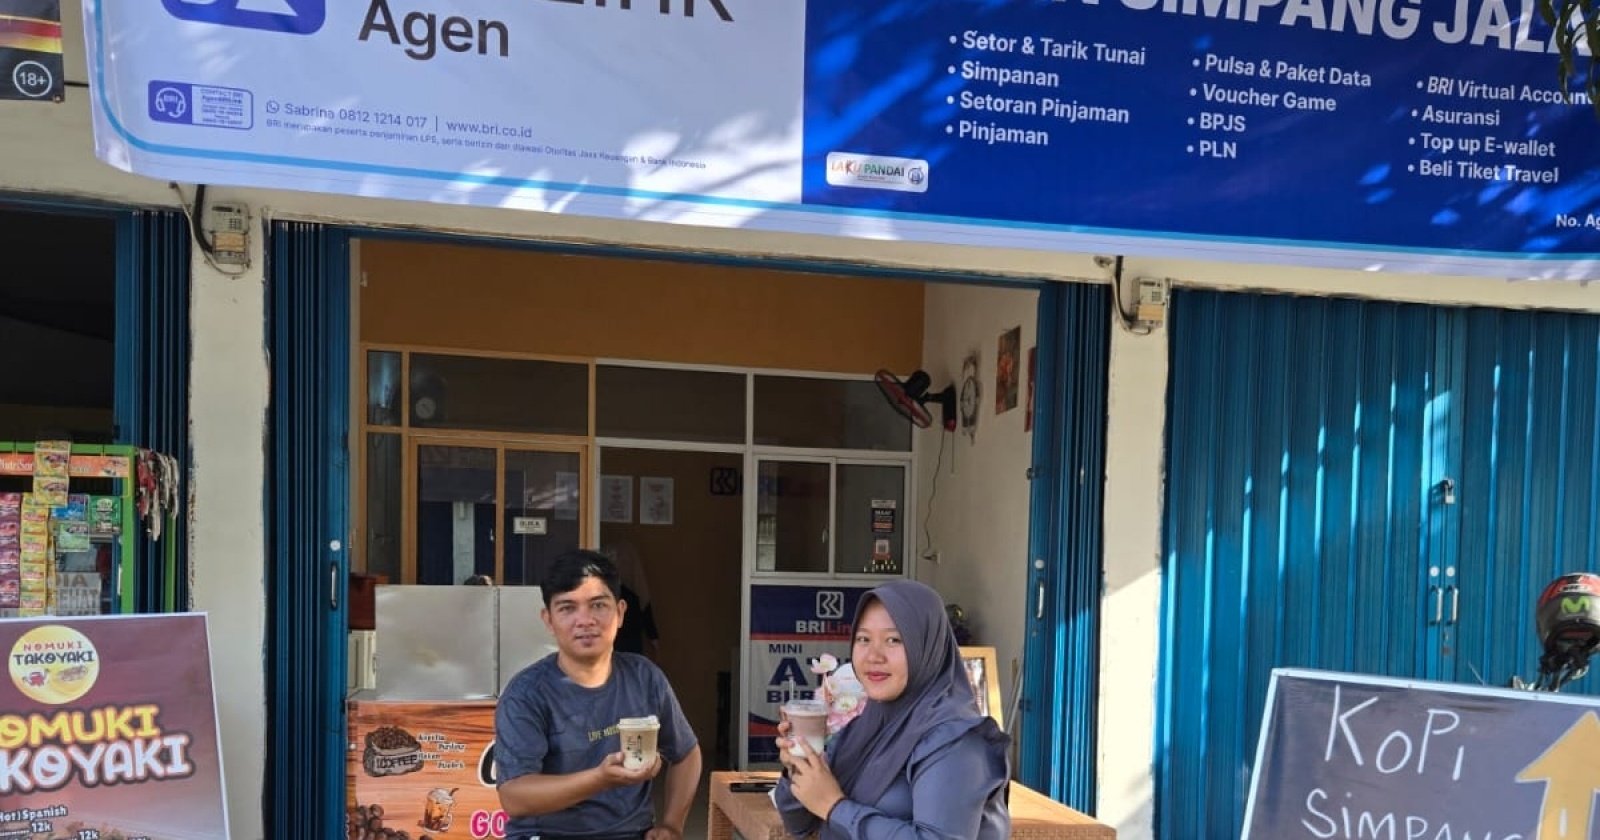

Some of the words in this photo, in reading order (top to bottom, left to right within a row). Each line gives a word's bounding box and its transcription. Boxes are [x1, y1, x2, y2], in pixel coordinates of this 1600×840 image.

[358, 0, 509, 61] Agen
[962, 30, 1016, 53] Setor
[1021, 36, 1036, 55] &
[1040, 37, 1089, 61] Tarik
[1093, 43, 1146, 66] Tunai
[19, 71, 47, 87] 18+
[960, 60, 1060, 88] Simpanan
[1205, 53, 1254, 76] Pulsa
[1259, 59, 1272, 79] &
[1275, 62, 1326, 84] Paket
[1329, 67, 1372, 88] Data
[1202, 83, 1279, 107] Voucher
[1283, 91, 1337, 112] Game
[1427, 75, 1454, 96] BRI
[1458, 79, 1515, 100] Virtual
[284, 103, 335, 120] Sabrina
[339, 108, 370, 123] 0812
[374, 112, 401, 126] 1214
[406, 115, 427, 128] 017
[959, 91, 1037, 116] Setoran
[1041, 97, 1130, 124] Pinjaman
[1421, 105, 1500, 126] Asuransi
[446, 121, 533, 138] www.bri.co.id
[1200, 112, 1246, 132] BPJS
[958, 119, 1049, 147] Pinjaman
[1200, 140, 1237, 159] PLN
[1421, 132, 1454, 154] Top
[1458, 137, 1481, 155] up
[1484, 136, 1556, 157] E-wallet
[863, 163, 905, 177] PANDAI
[1420, 160, 1453, 177] Beli
[1456, 161, 1502, 181] Tiket
[1503, 164, 1559, 184] Travel
[1556, 213, 1581, 228] No.
[795, 620, 853, 634] BRILin
[23, 640, 83, 651] NOMUKI
[768, 643, 803, 654] MINI
[13, 650, 95, 666] TAKOYAKI
[766, 690, 816, 703] BER
[31, 821, 52, 833] 12k
